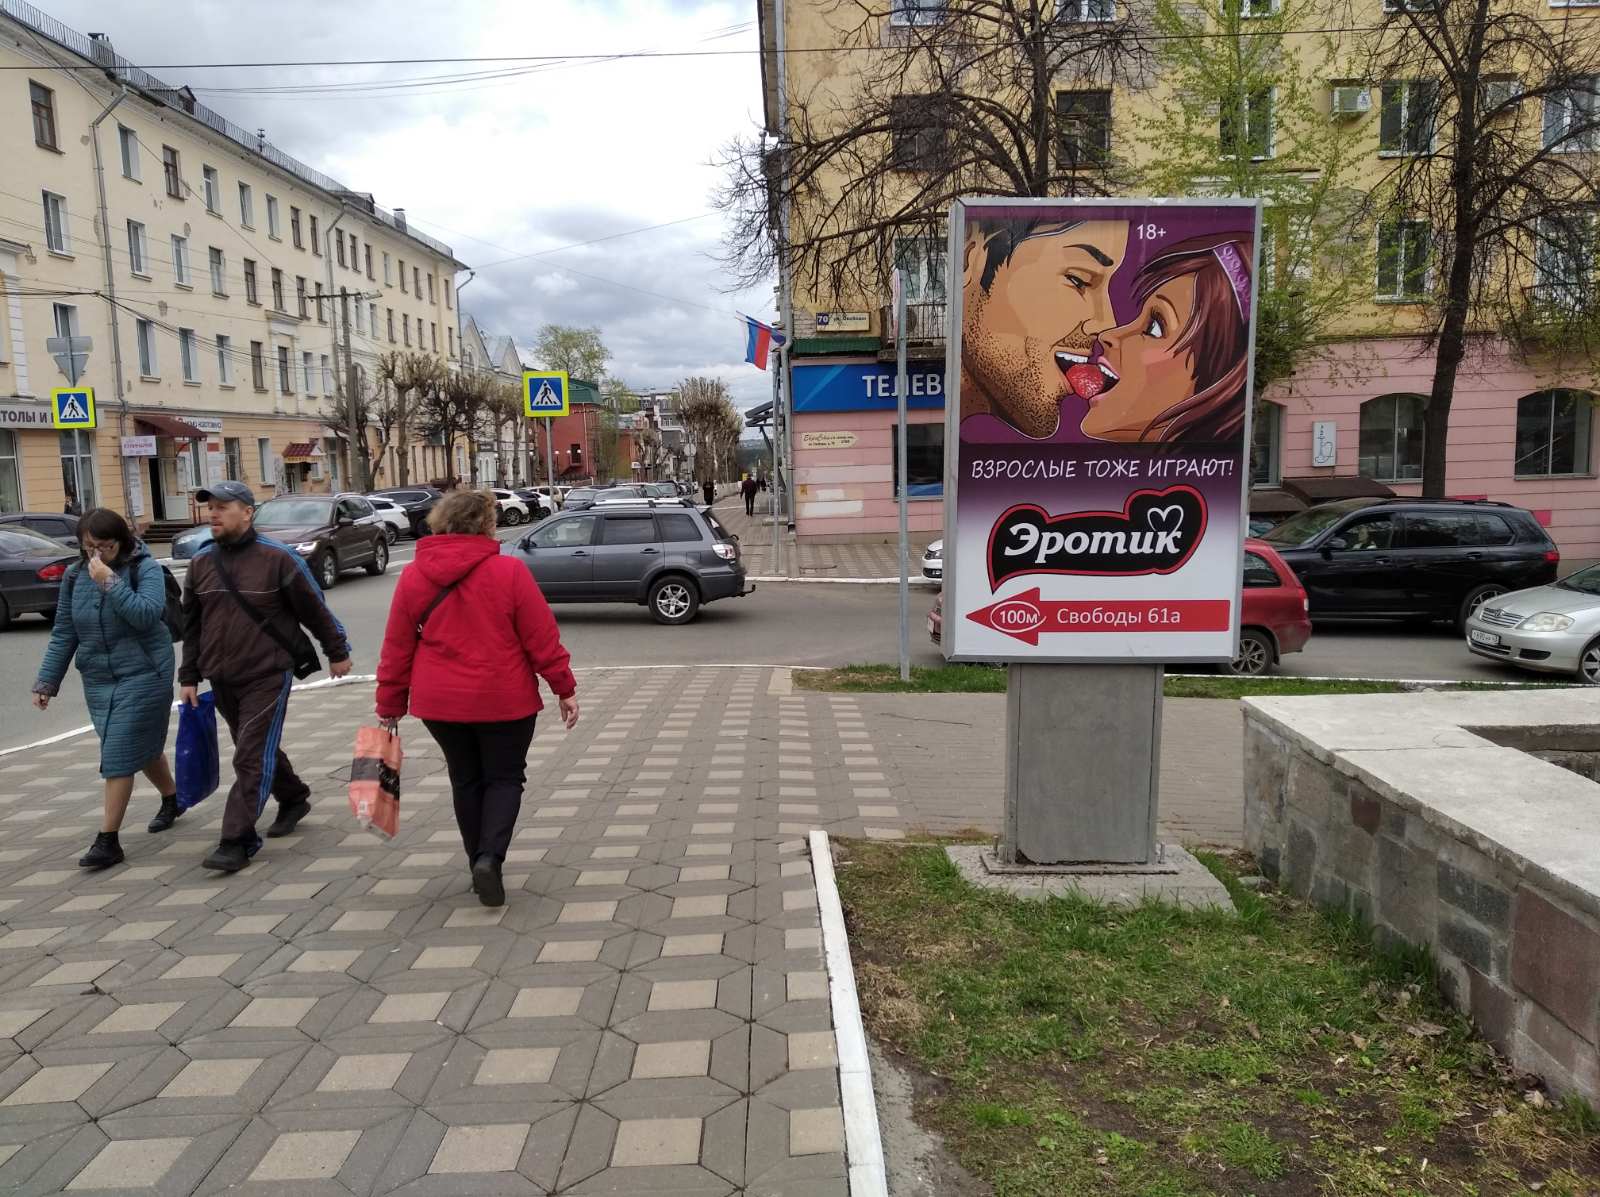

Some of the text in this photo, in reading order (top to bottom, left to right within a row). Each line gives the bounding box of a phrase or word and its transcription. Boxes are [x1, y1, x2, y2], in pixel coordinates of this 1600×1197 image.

[1137, 223, 1167, 240] 18+
[817, 315, 829, 323] 70
[862, 373, 945, 397] ТЕЛЕВ
[0, 410, 36, 423] ТОЛЫ
[39, 411, 48, 423] И
[971, 458, 1234, 479] ВЗРОСЛЫЕ ТОЖЕ ИГРАЮТ!
[1003, 522, 1183, 564] Эротик
[999, 607, 1181, 627] 100м Свободы 61а
